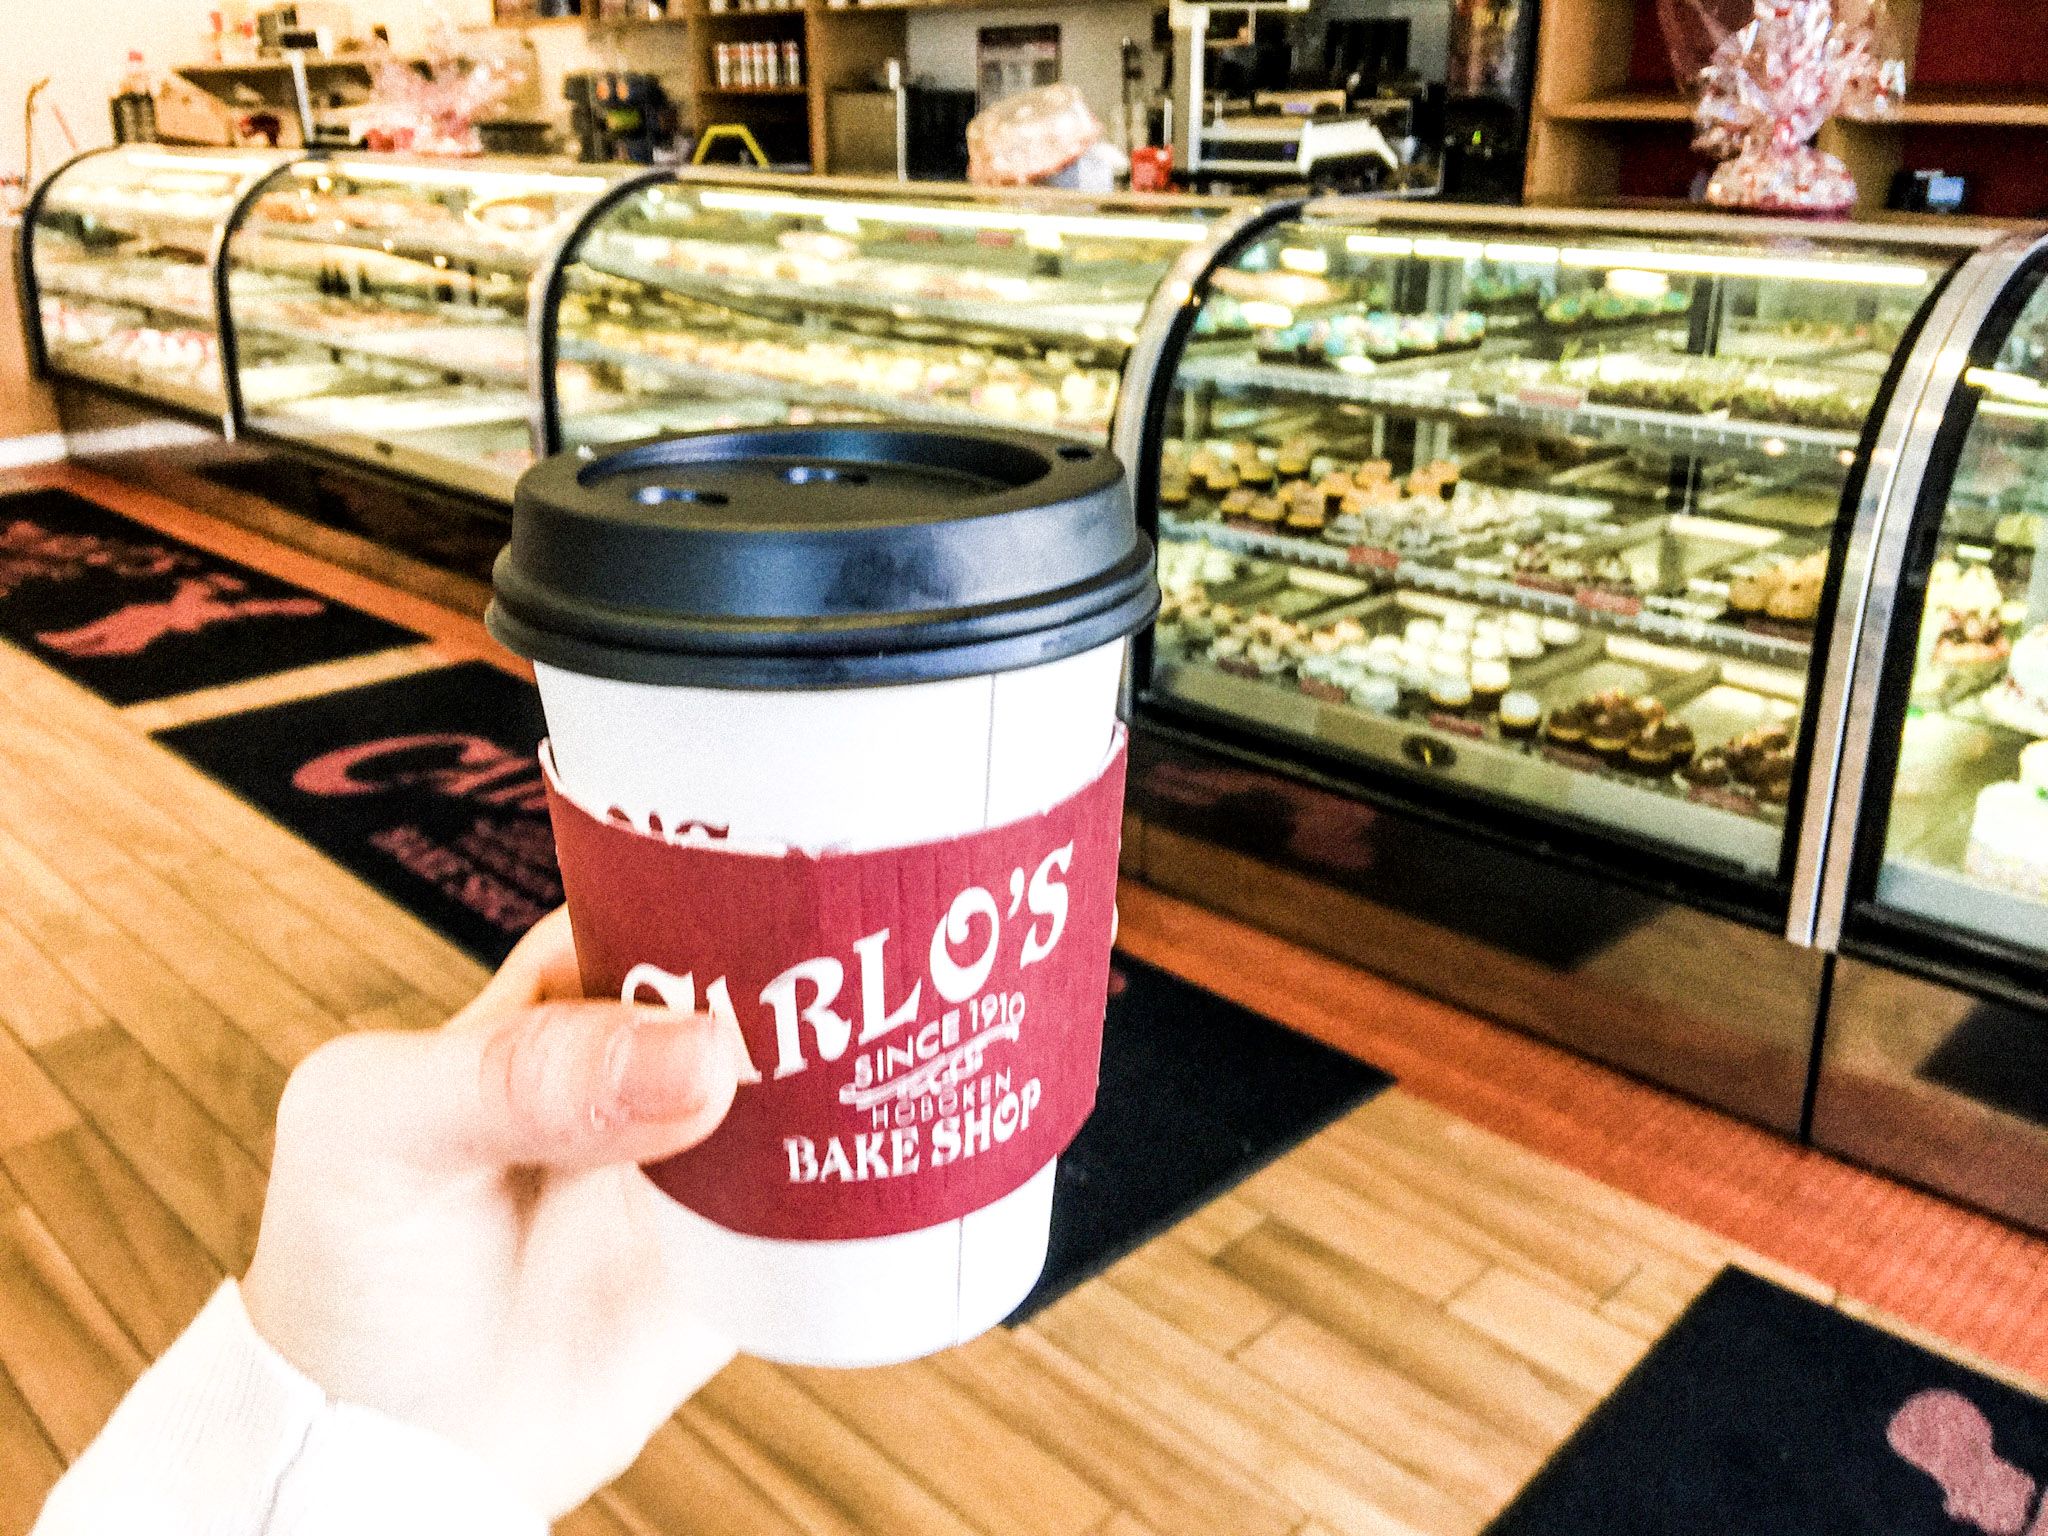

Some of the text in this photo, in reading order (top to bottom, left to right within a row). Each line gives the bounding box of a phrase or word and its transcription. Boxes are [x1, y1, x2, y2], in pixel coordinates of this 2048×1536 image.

[854, 991, 1026, 1088] SINCE 1910
[783, 1077, 1042, 1183] BAKE SHOP
[871, 1066, 1011, 1130] HOBOKEN
